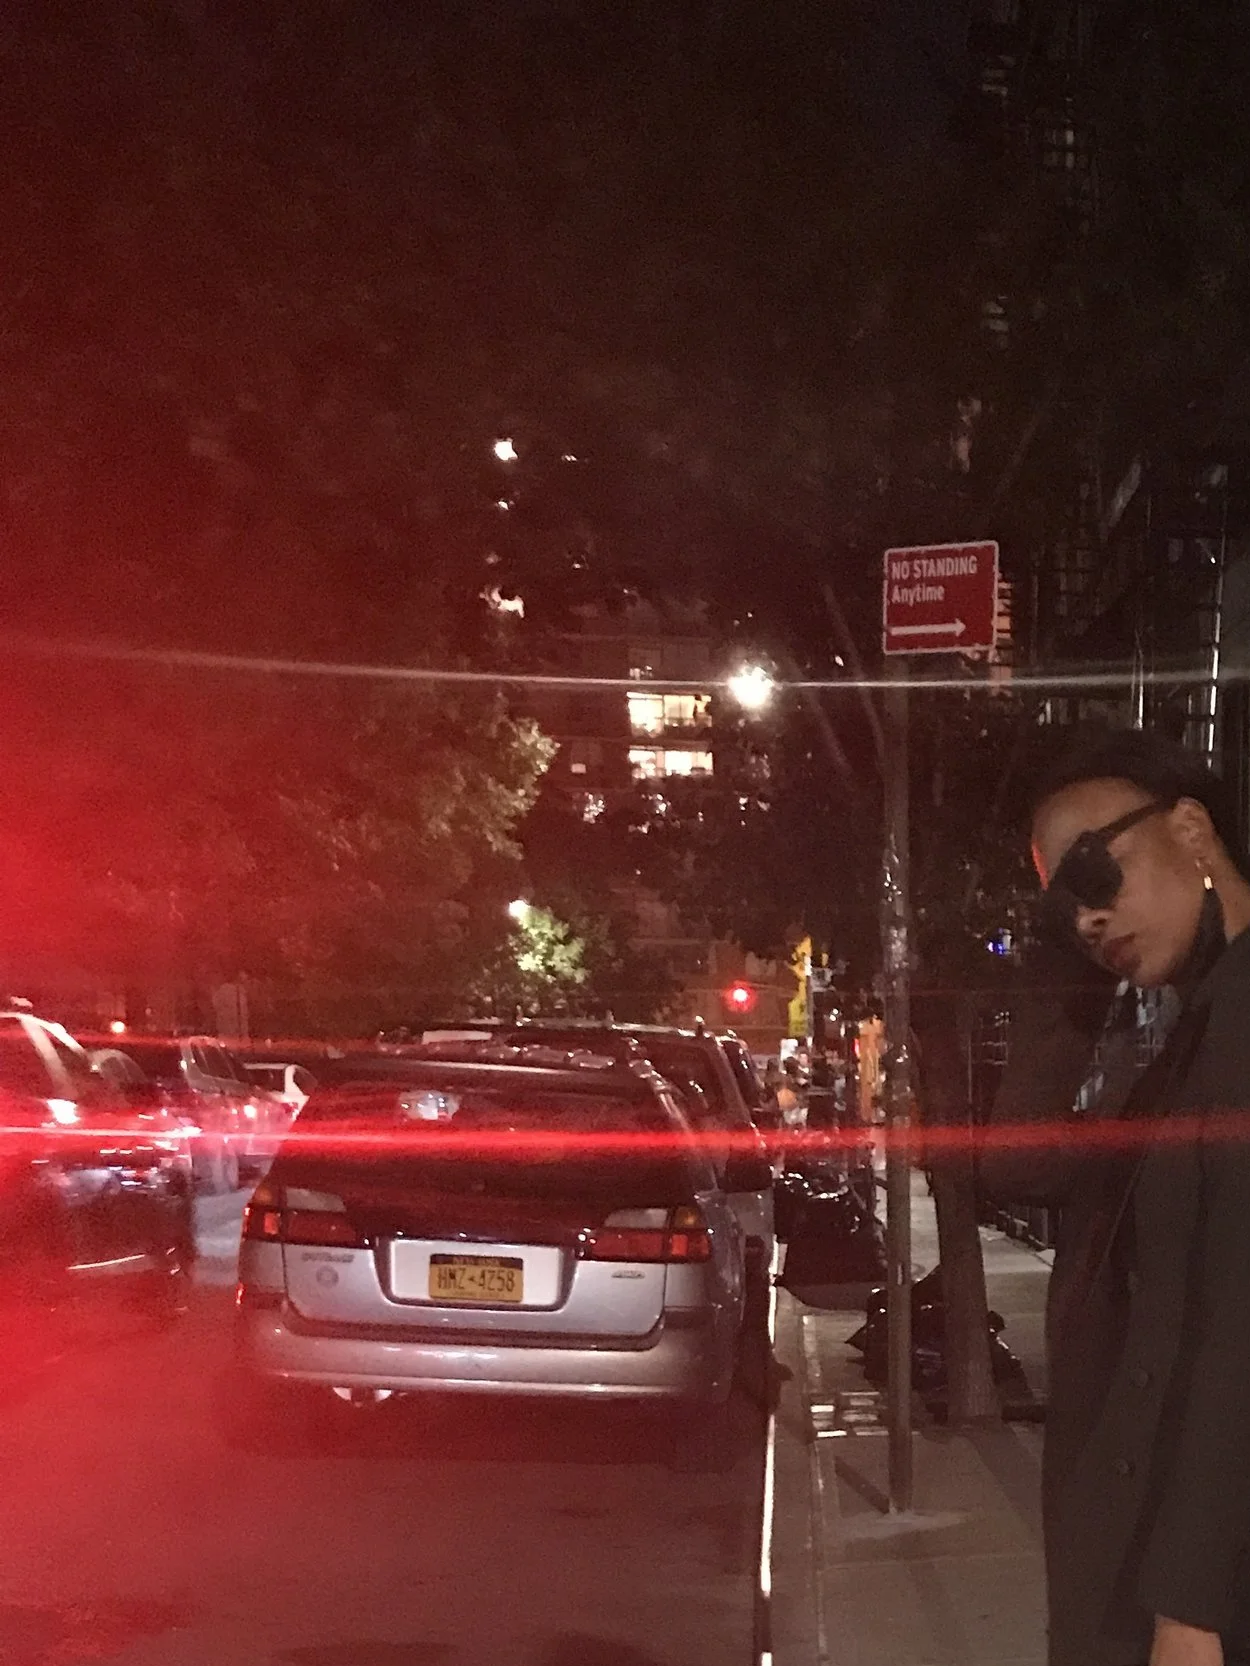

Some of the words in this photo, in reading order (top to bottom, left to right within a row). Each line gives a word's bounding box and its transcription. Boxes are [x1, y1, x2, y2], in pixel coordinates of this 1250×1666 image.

[892, 562, 911, 579] NO
[913, 555, 978, 578] STANDING
[891, 584, 945, 607] Anytime
